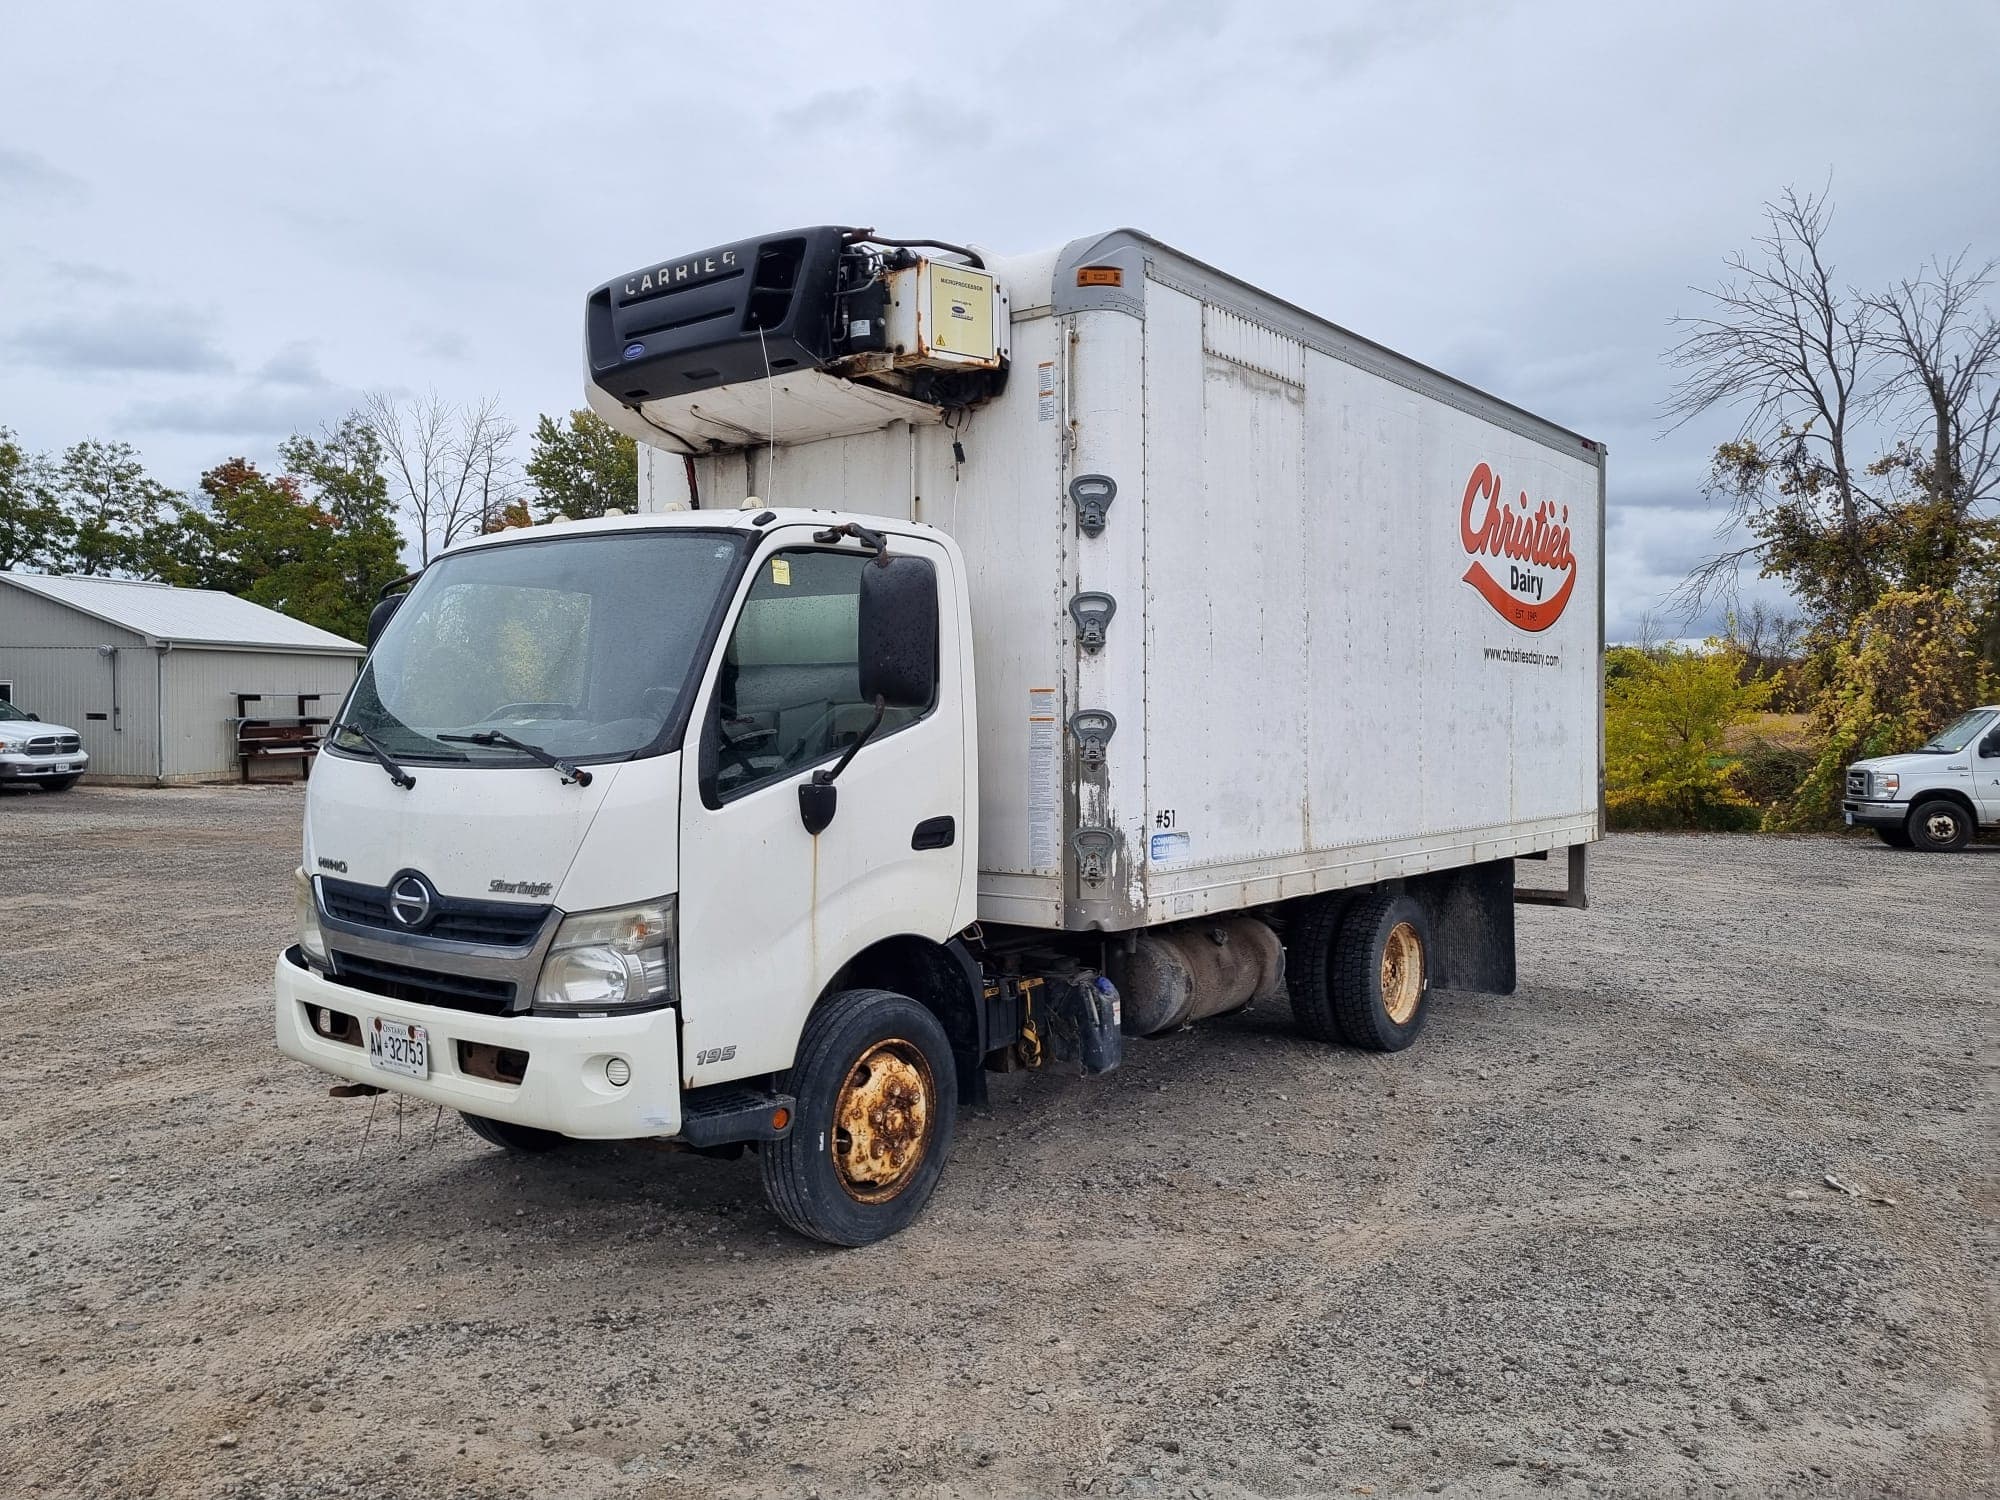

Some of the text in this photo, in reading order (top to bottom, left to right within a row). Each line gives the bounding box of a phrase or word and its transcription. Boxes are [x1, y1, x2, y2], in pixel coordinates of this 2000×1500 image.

[625, 251, 736, 295] CARRIER
[940, 277, 984, 292] MICROPROCESSOR
[1510, 565, 1545, 601] Dairy
[1483, 646, 1560, 669] www.christiesdairy.com
[1155, 809, 1176, 829] #51
[318, 856, 348, 874] HINO
[388, 1036, 424, 1066] 32753
[696, 1044, 737, 1066] 195
